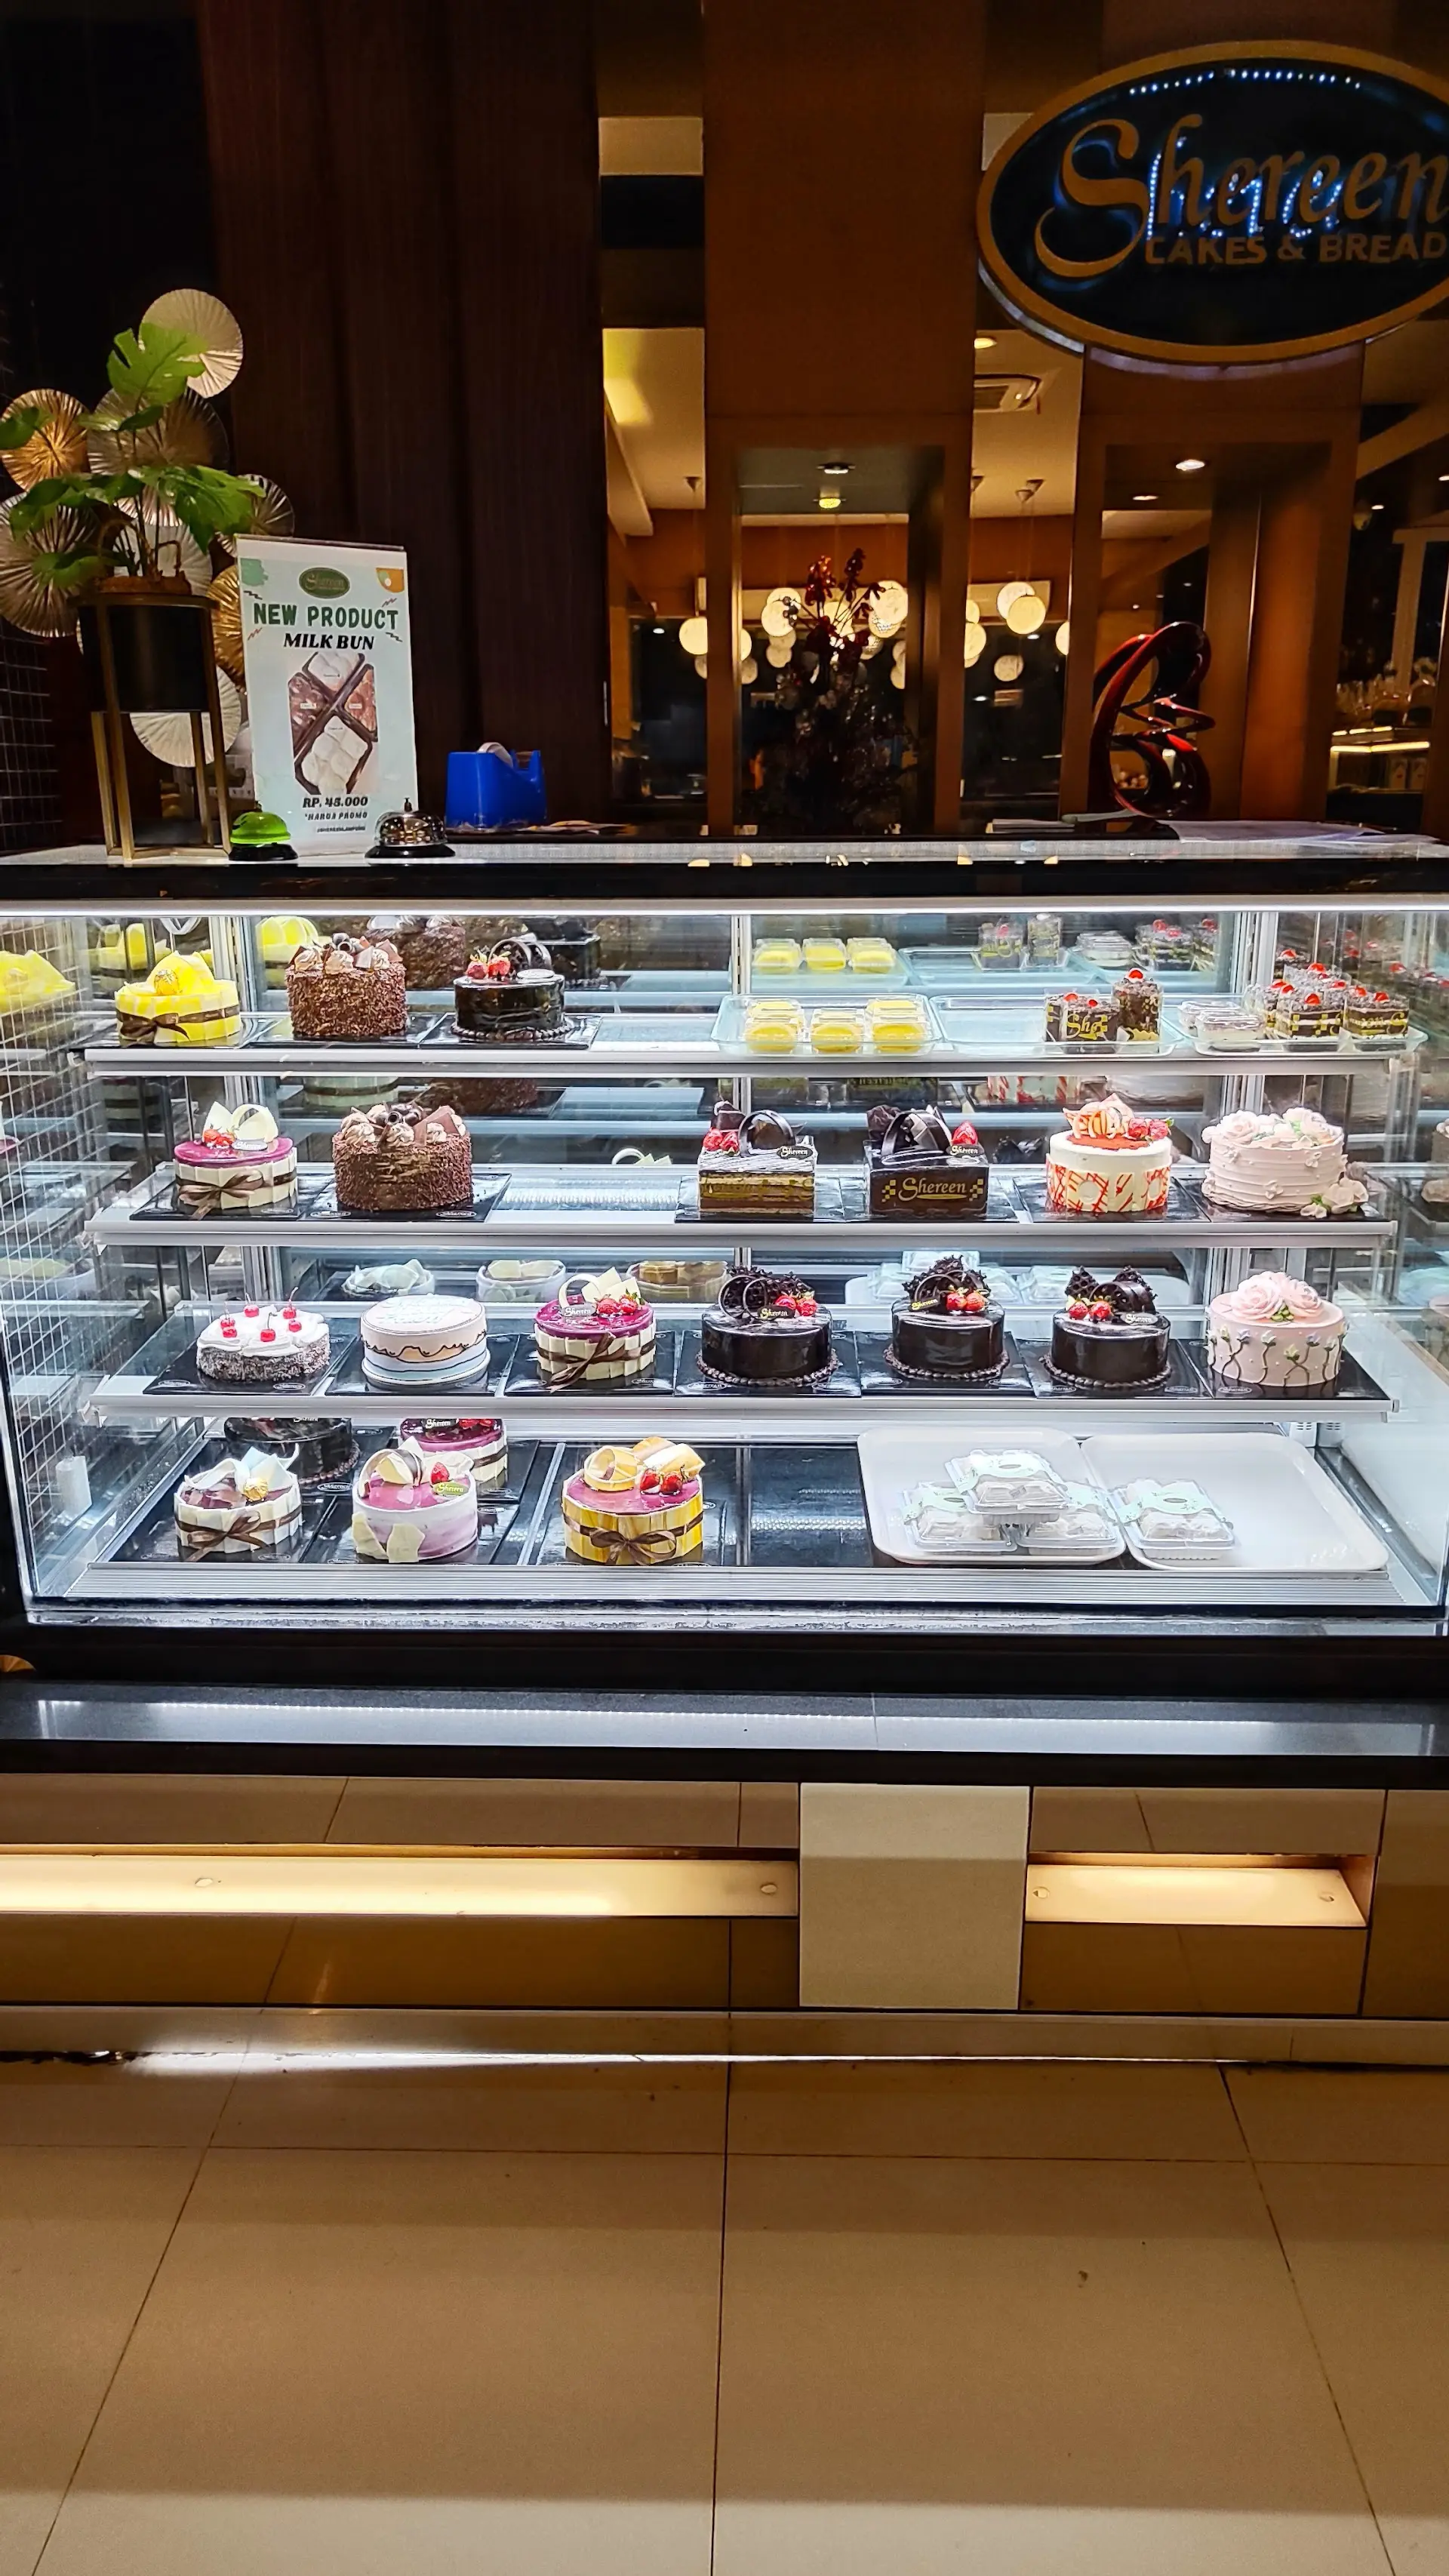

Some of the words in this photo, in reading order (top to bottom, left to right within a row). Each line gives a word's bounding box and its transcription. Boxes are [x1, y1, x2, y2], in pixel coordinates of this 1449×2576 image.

[1035, 113, 1448, 278] Shereen
[1145, 235, 1267, 265] CAKES
[1277, 235, 1306, 261] &
[1318, 232, 1447, 263] BREAD
[253, 602, 297, 626] NEW
[307, 606, 398, 630] PRODUCT
[283, 632, 333, 649] MILK
[336, 635, 374, 651] BUN
[302, 797, 322, 808] RP.
[339, 811, 368, 820] PROMO
[898, 1177, 967, 1202] Shereen
